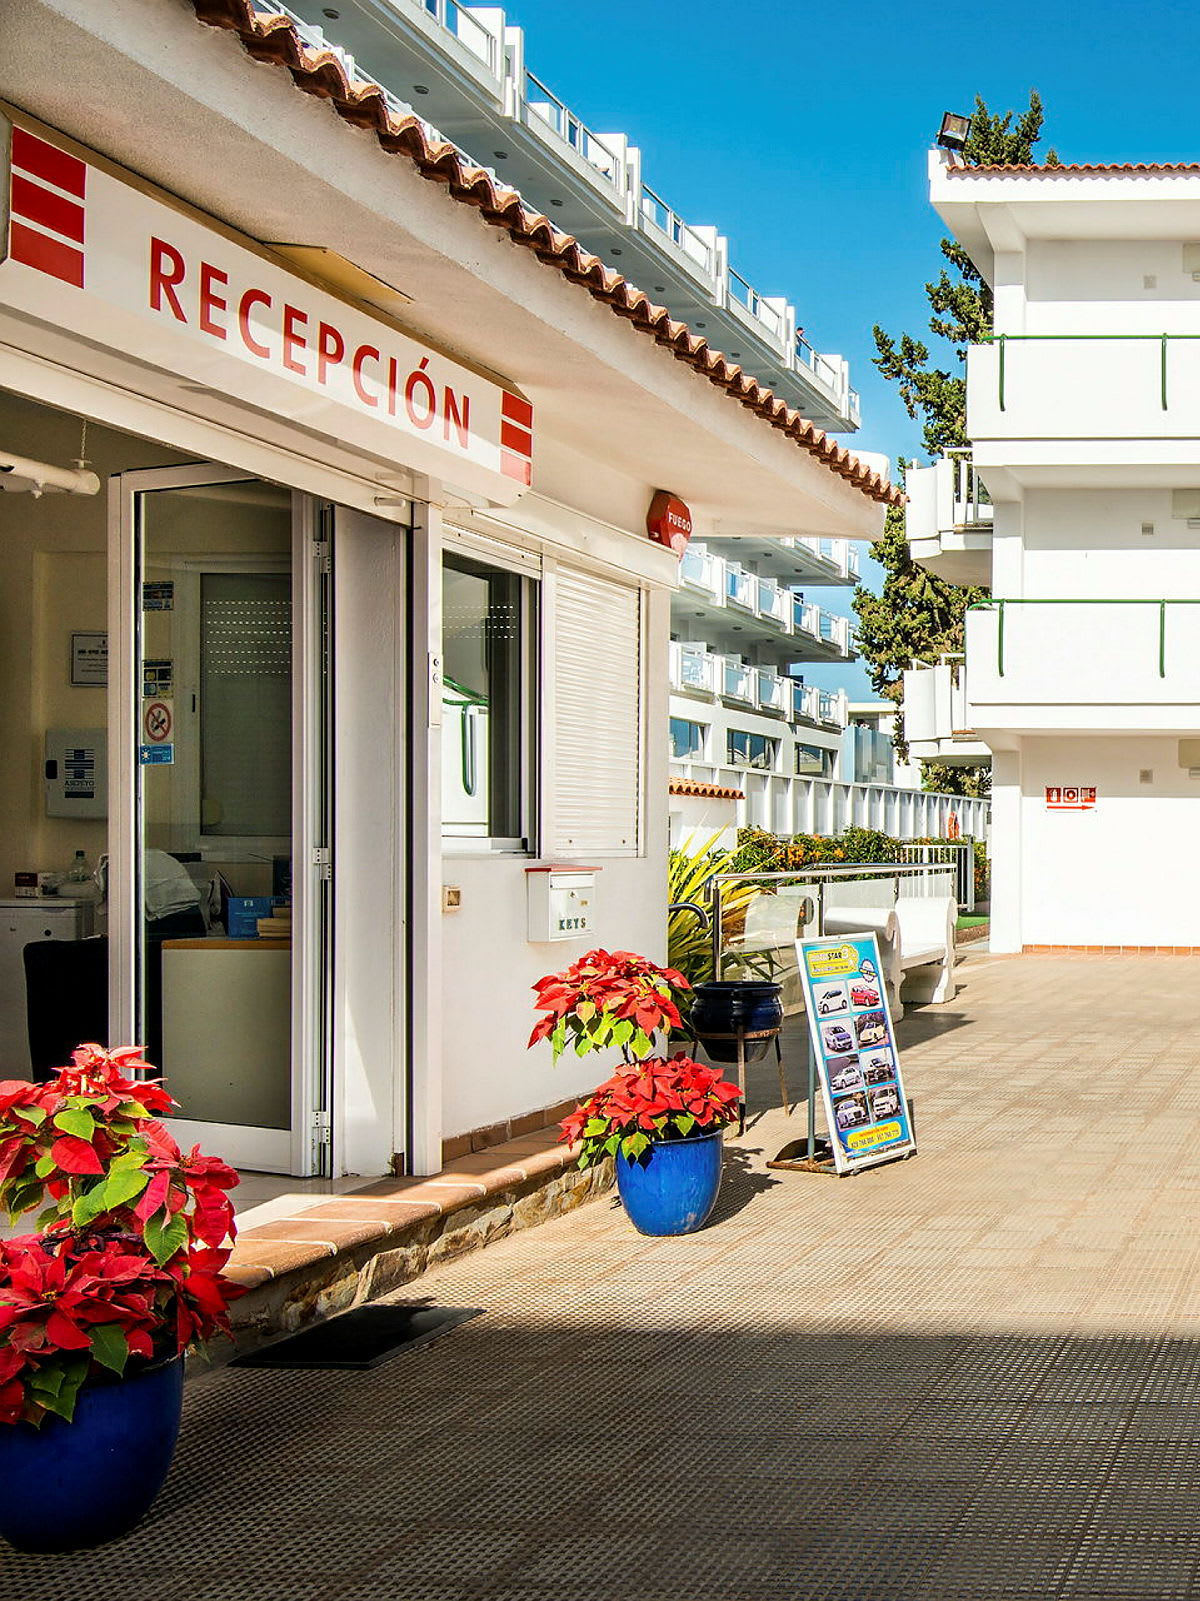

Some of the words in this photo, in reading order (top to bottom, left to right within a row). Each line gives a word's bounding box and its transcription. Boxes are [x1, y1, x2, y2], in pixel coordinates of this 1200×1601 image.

[149, 235, 470, 450] RECEPCIÓN
[668, 511, 691, 532] FUEGO
[559, 917, 586, 931] KEYS
[827, 952, 842, 960] STAR
